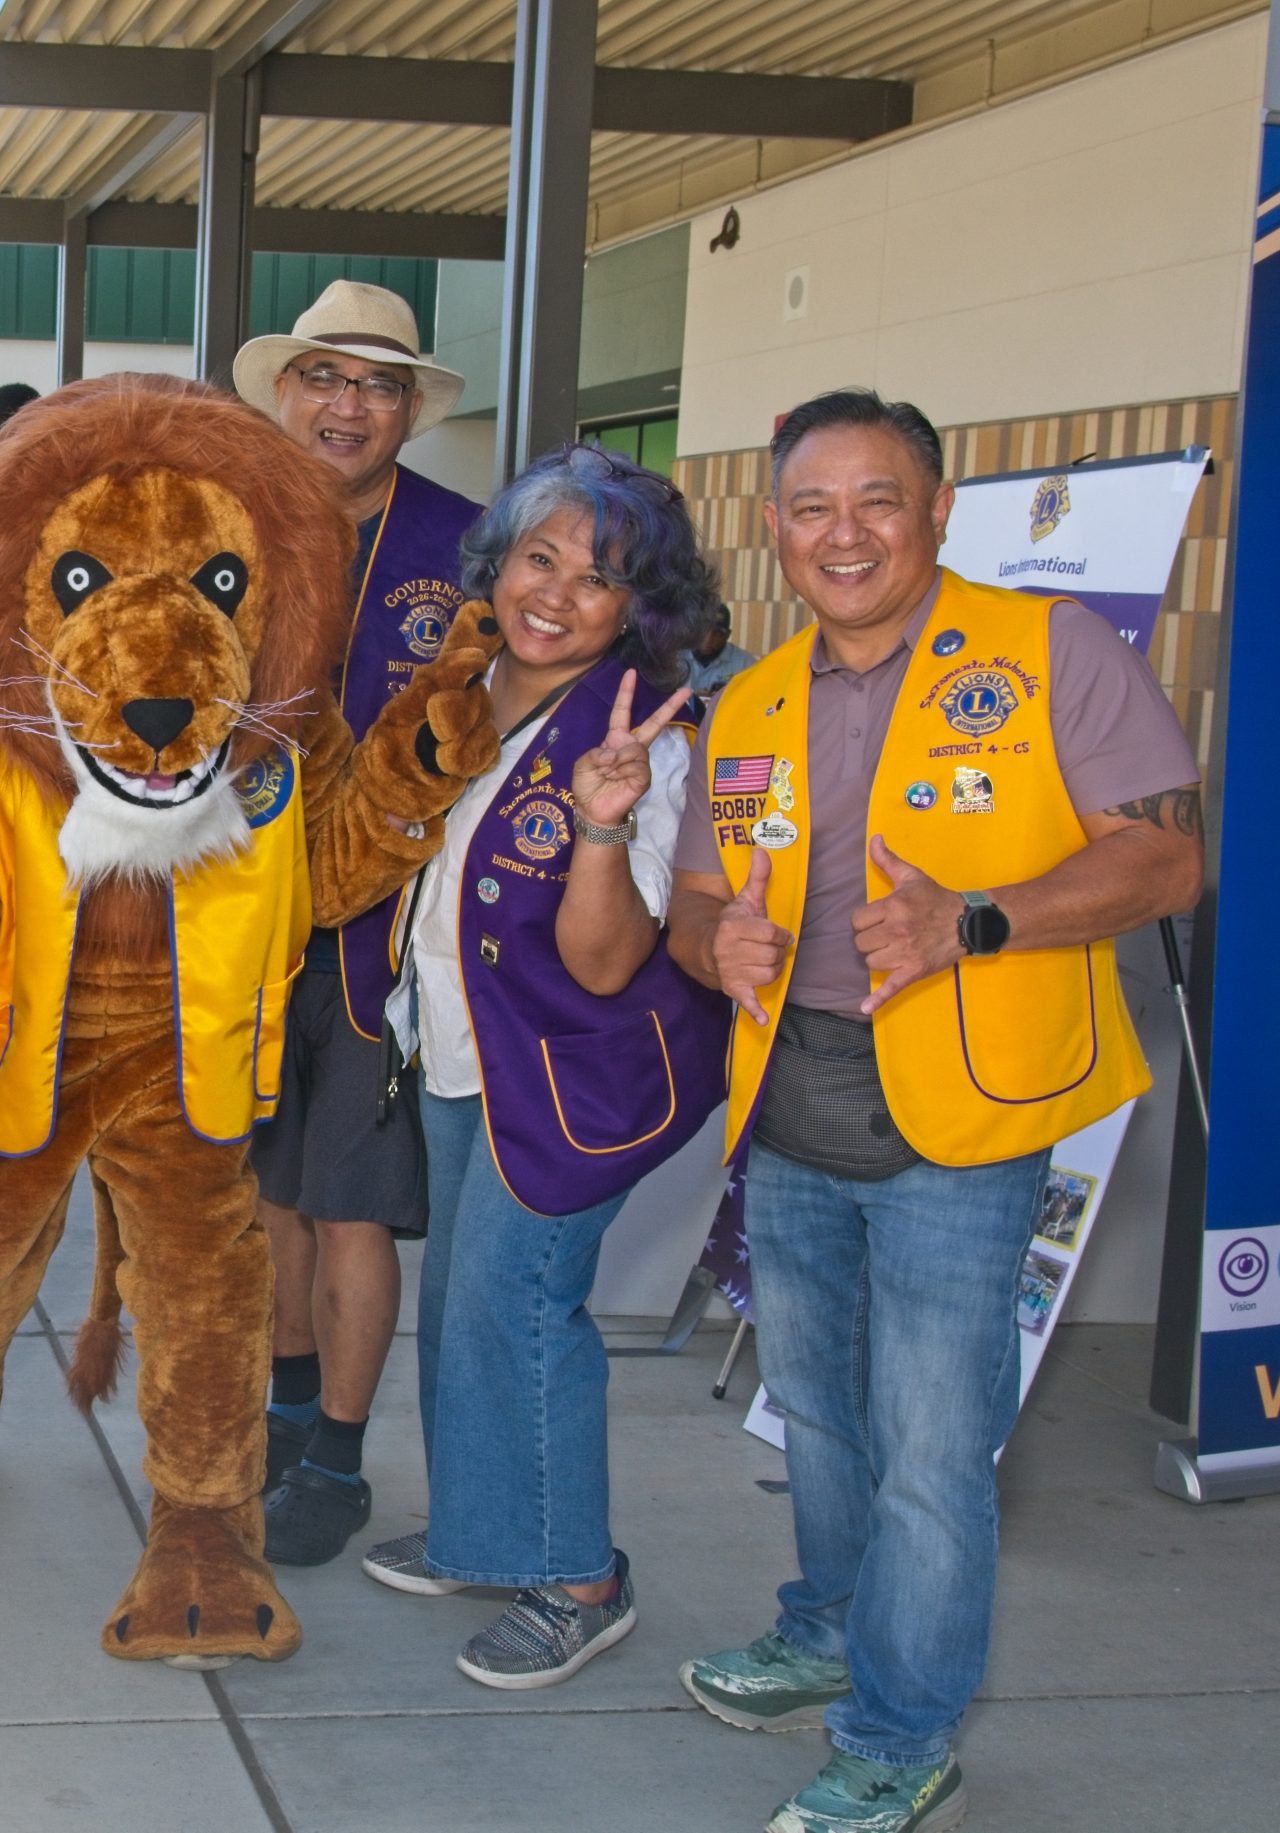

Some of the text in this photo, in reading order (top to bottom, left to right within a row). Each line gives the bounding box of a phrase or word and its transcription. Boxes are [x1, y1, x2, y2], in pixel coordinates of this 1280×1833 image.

[999, 556, 1087, 577] Lions International
[412, 606, 448, 621] LIONS
[422, 621, 438, 641] L
[920, 656, 1041, 710] Sacramento Maharlika
[961, 674, 1004, 688] LIONS
[969, 691, 989, 713] L
[954, 719, 1001, 731] INTERNATIONAL
[928, 743, 982, 757] DISTRICT
[988, 744, 998, 754] 4
[498, 783, 555, 818] Sacramento
[712, 798, 766, 821] BOBBY
[528, 802, 564, 822] LIONS
[531, 818, 548, 841] L
[519, 841, 553, 858] INTERNATIONAL
[491, 854, 535, 877] DISTRICT
[536, 871, 546, 880] 4
[1229, 1302, 1257, 1312] Vision
